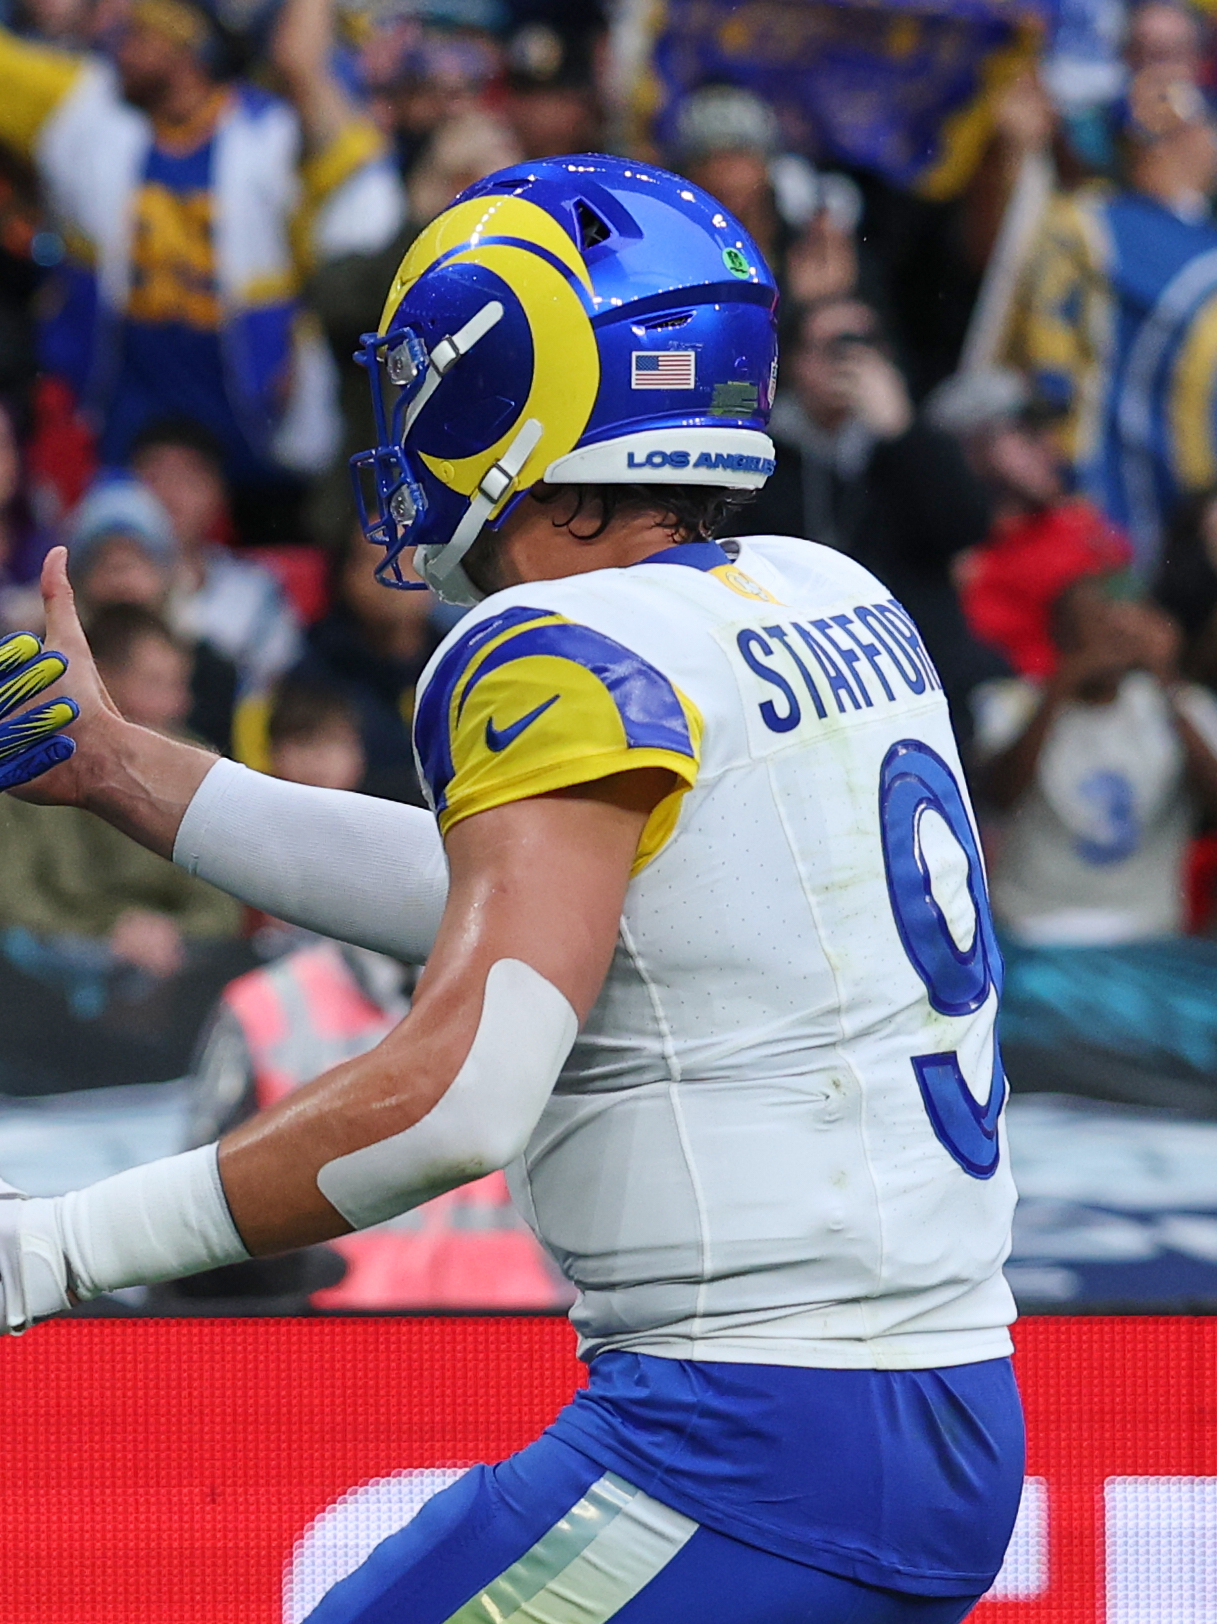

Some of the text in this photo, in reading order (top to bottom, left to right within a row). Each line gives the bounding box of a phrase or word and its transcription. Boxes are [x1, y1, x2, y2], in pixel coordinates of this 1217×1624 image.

[627, 450, 690, 469] LOS
[736, 599, 944, 733] STAFFOR
[1072, 767, 1139, 867] 3
[878, 738, 1005, 1180] 9
